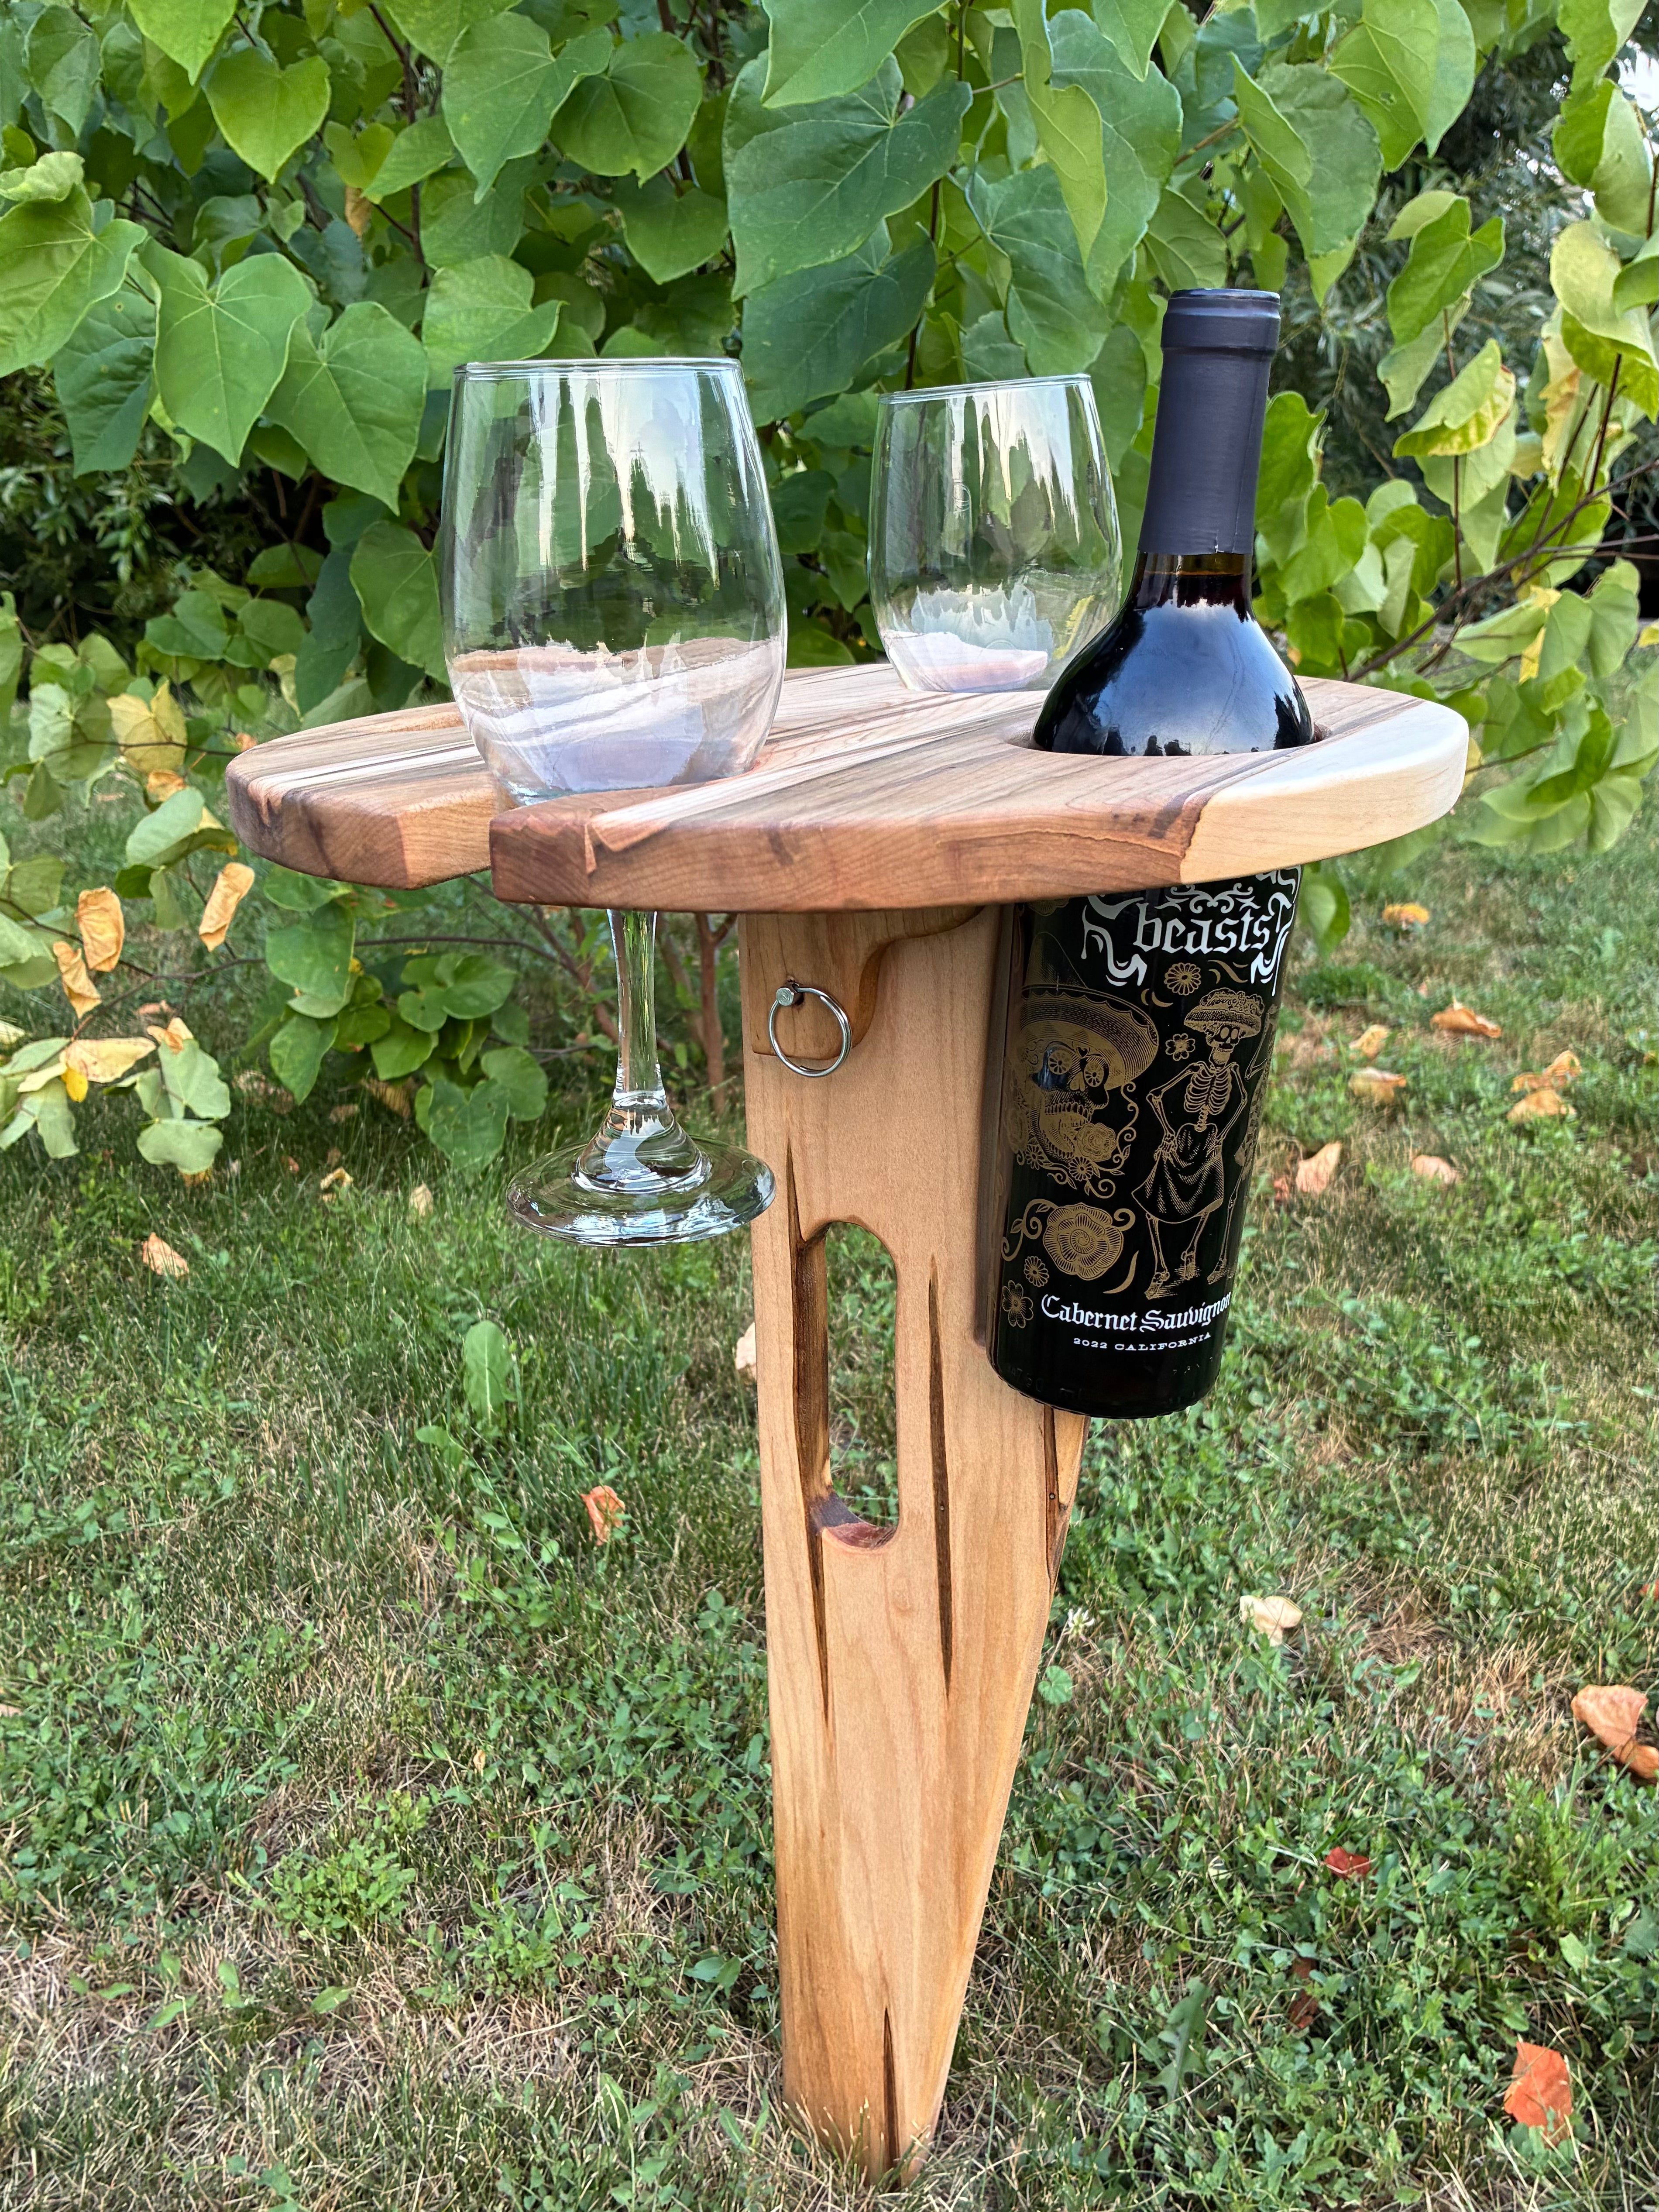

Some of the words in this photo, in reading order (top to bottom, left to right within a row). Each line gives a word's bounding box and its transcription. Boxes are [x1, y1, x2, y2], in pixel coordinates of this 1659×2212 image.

[1133, 903, 1274, 955] beasts
[1041, 1294, 1137, 1331] Cabernet
[1139, 1291, 1231, 1332] Sauvignon
[1073, 1338, 1108, 1349] 2022
[1115, 1332, 1211, 1351] CALIFORNIA
